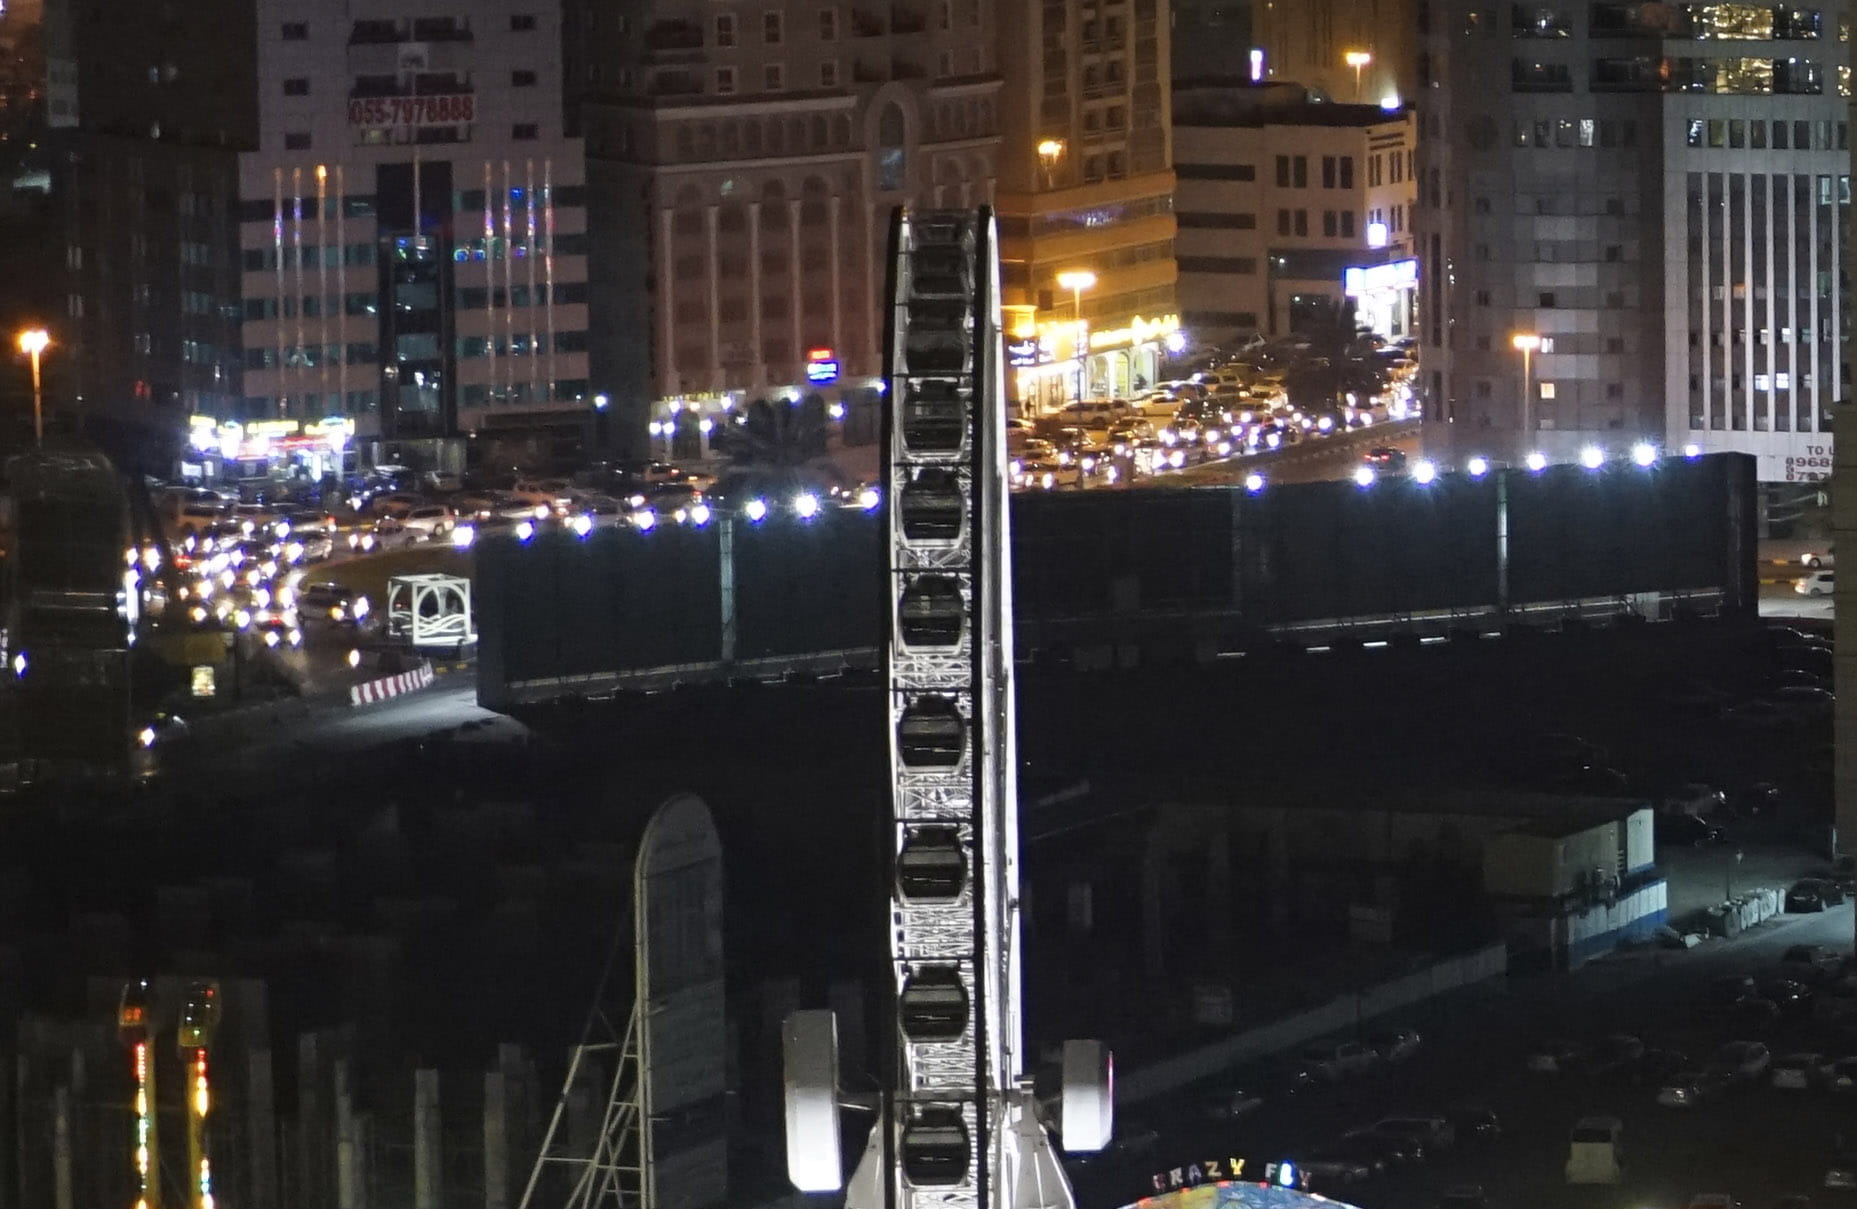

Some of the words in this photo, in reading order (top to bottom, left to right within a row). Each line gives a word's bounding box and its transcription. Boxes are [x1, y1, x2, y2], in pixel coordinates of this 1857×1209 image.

[1806, 445, 1824, 456] TO
[1152, 1157, 1246, 1190] CRAZY
[1265, 1162, 1313, 1188] FLY
